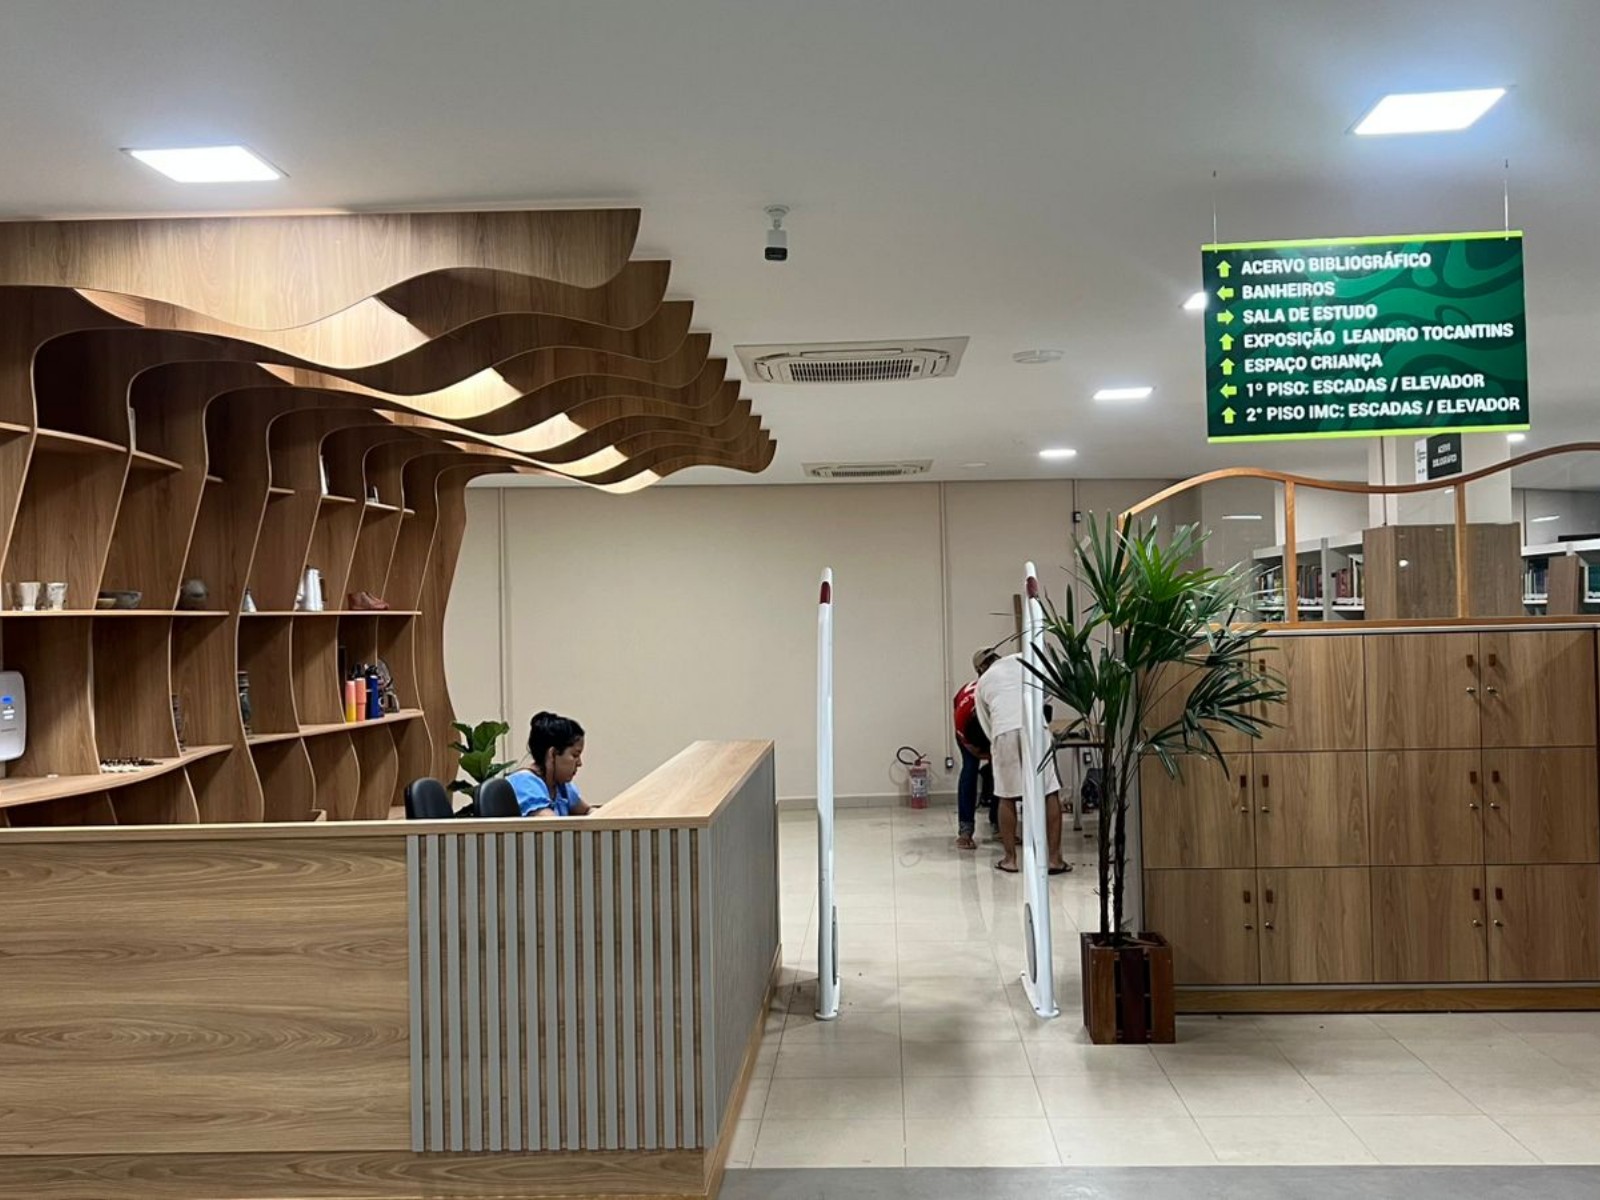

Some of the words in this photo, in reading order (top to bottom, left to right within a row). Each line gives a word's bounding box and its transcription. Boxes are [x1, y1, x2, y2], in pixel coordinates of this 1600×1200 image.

[1242, 258, 1305, 275] ACERVO
[1309, 252, 1431, 272] BIBLIOGRÁFICO
[1242, 281, 1335, 299] BANHEIROS
[1243, 309, 1285, 324] SALA
[1289, 307, 1310, 322] DE
[1313, 304, 1377, 321] ESTUDO
[1244, 328, 1335, 349] EXPOSIÇÃO
[1343, 326, 1418, 344] LEANDRO
[1422, 323, 1513, 340] TOCANTINS
[1245, 357, 1307, 375] ESPAÇO
[1311, 353, 1383, 371] CRIANÇA
[1267, 381, 1309, 396] PISO:
[1313, 378, 1387, 394] ESCADAS
[1390, 377, 1398, 392] /
[1401, 374, 1484, 391] ELEVADOR
[1267, 406, 1305, 420] PISO
[1309, 404, 1344, 419] IMC:
[1349, 401, 1422, 417] ESCADAS
[1426, 401, 1433, 415] /
[1437, 397, 1520, 414] ELEVADOR
